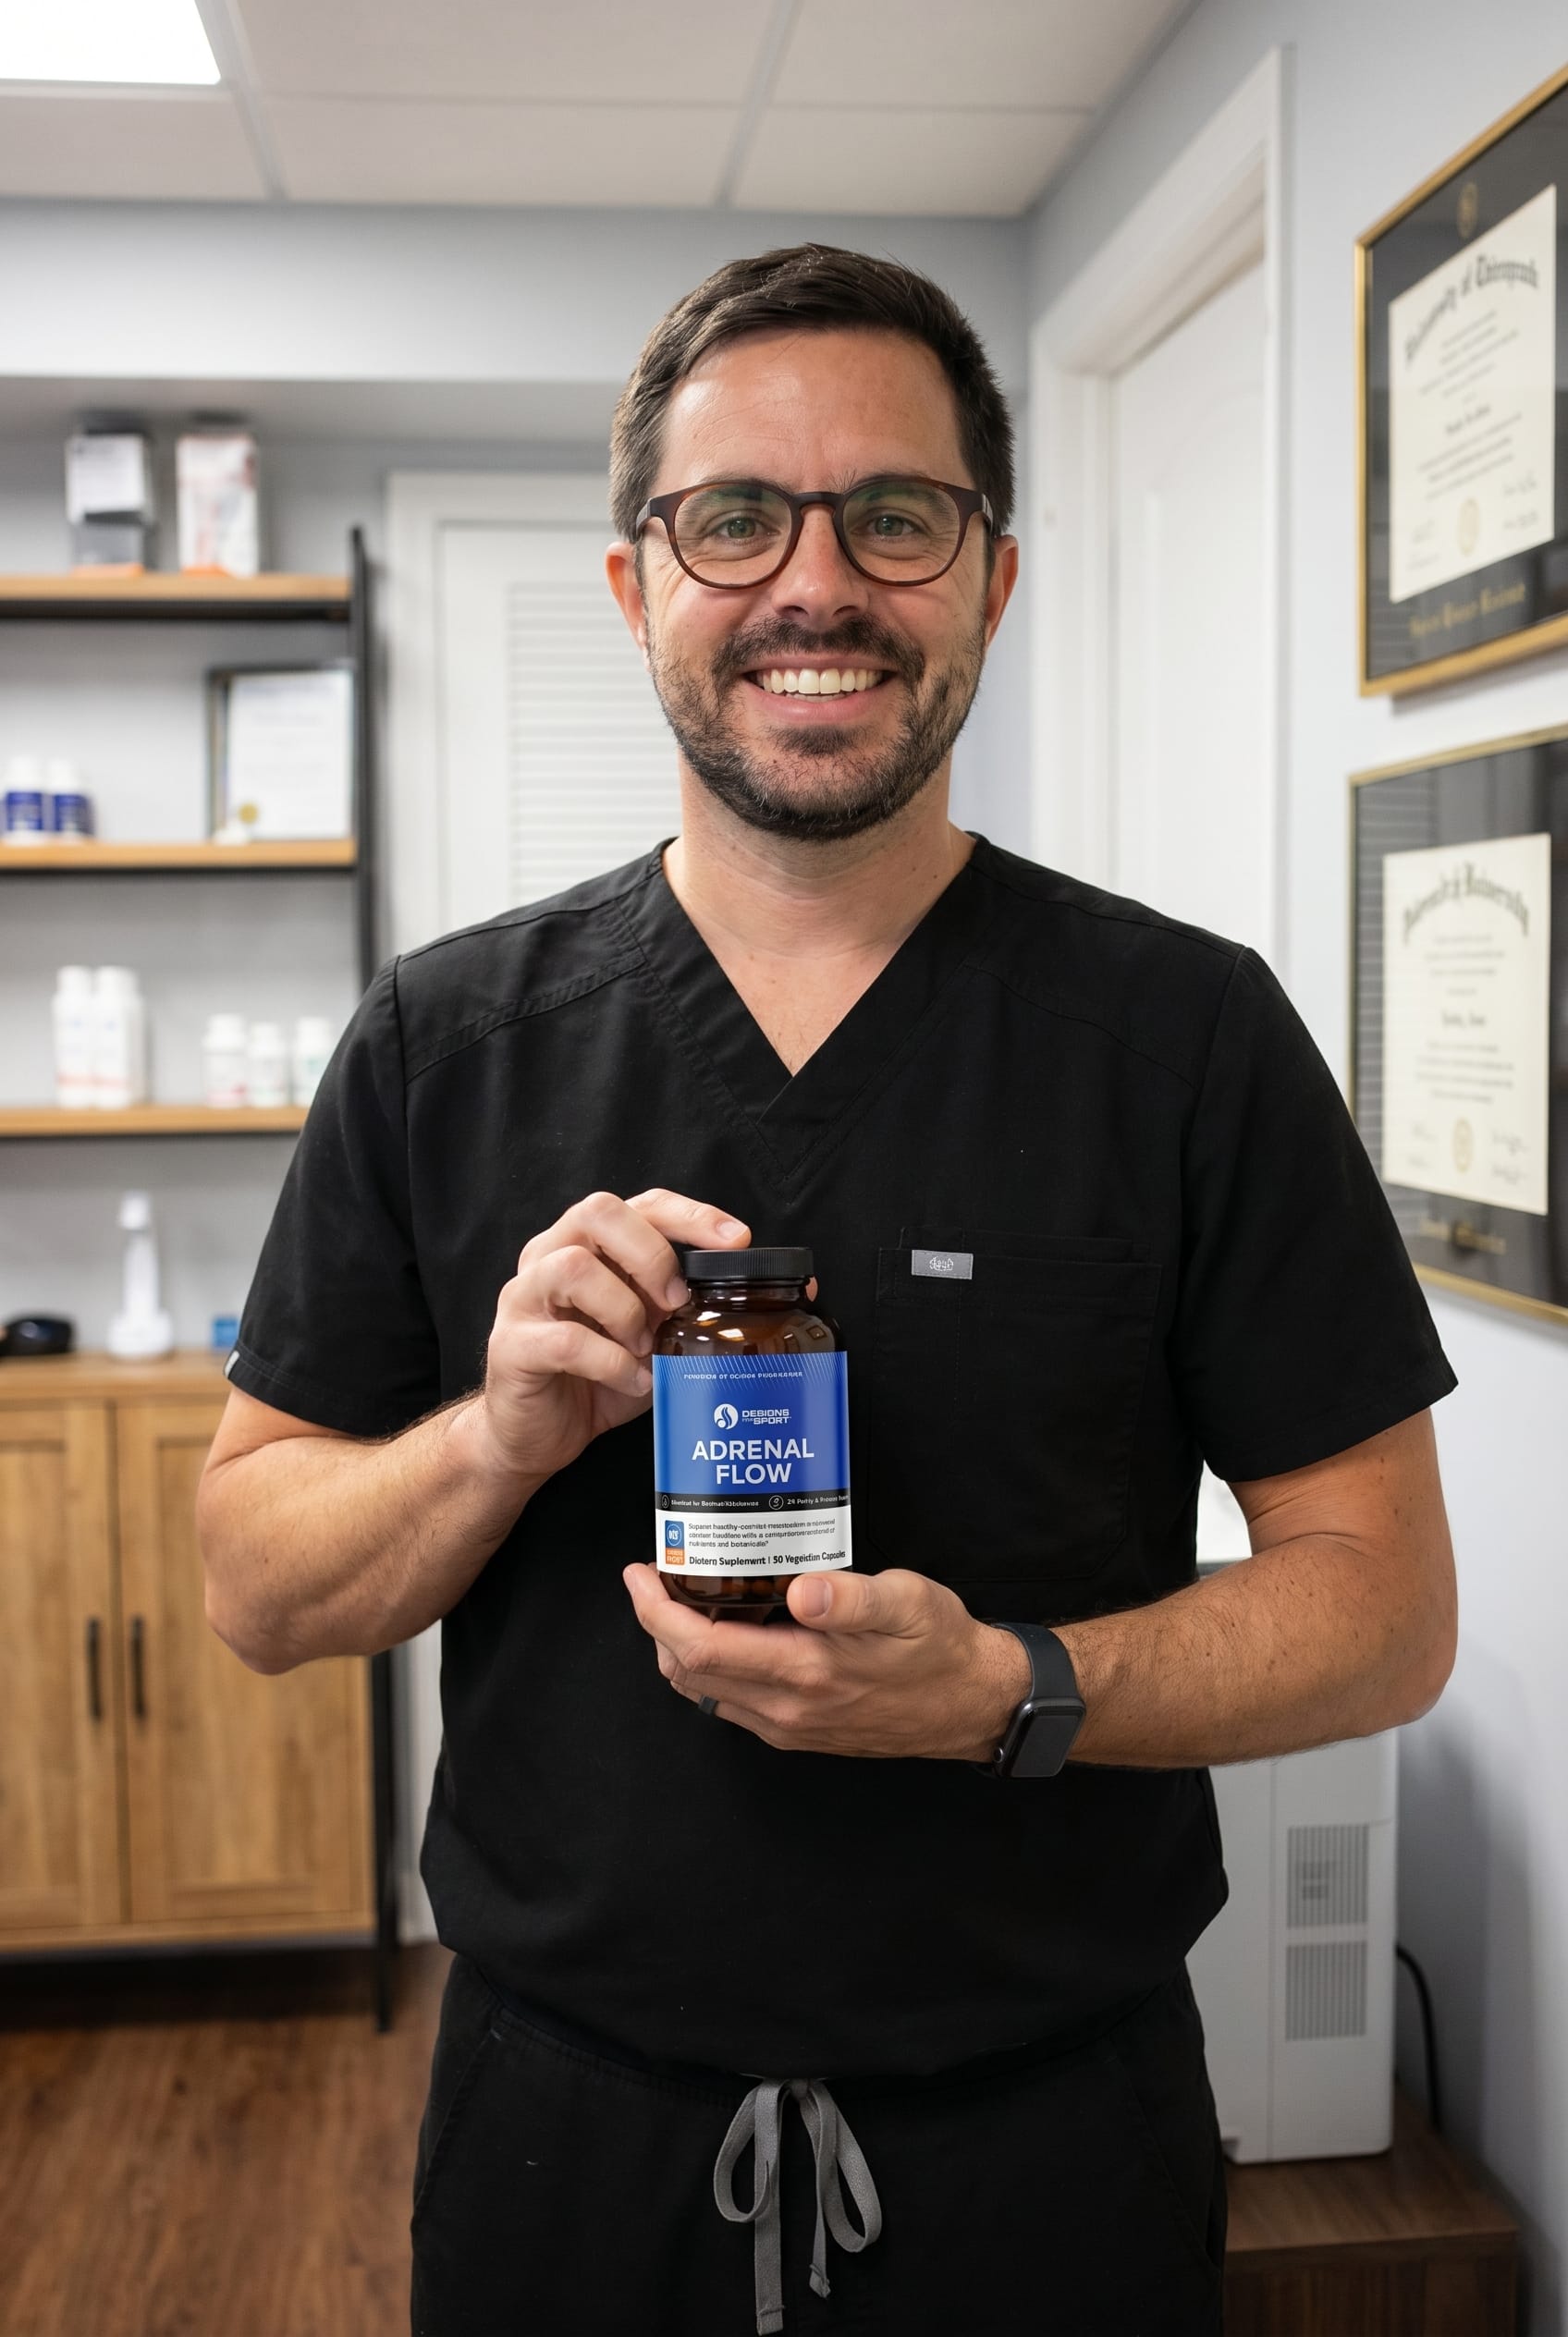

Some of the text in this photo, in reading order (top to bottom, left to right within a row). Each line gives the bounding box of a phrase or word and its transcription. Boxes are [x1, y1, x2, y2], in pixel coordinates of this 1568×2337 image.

[753, 1416, 789, 1425] SPORT
[692, 1438, 815, 1461] ADRENAL
[716, 1462, 792, 1485] FLOW
[773, 1555, 784, 1564] 50
